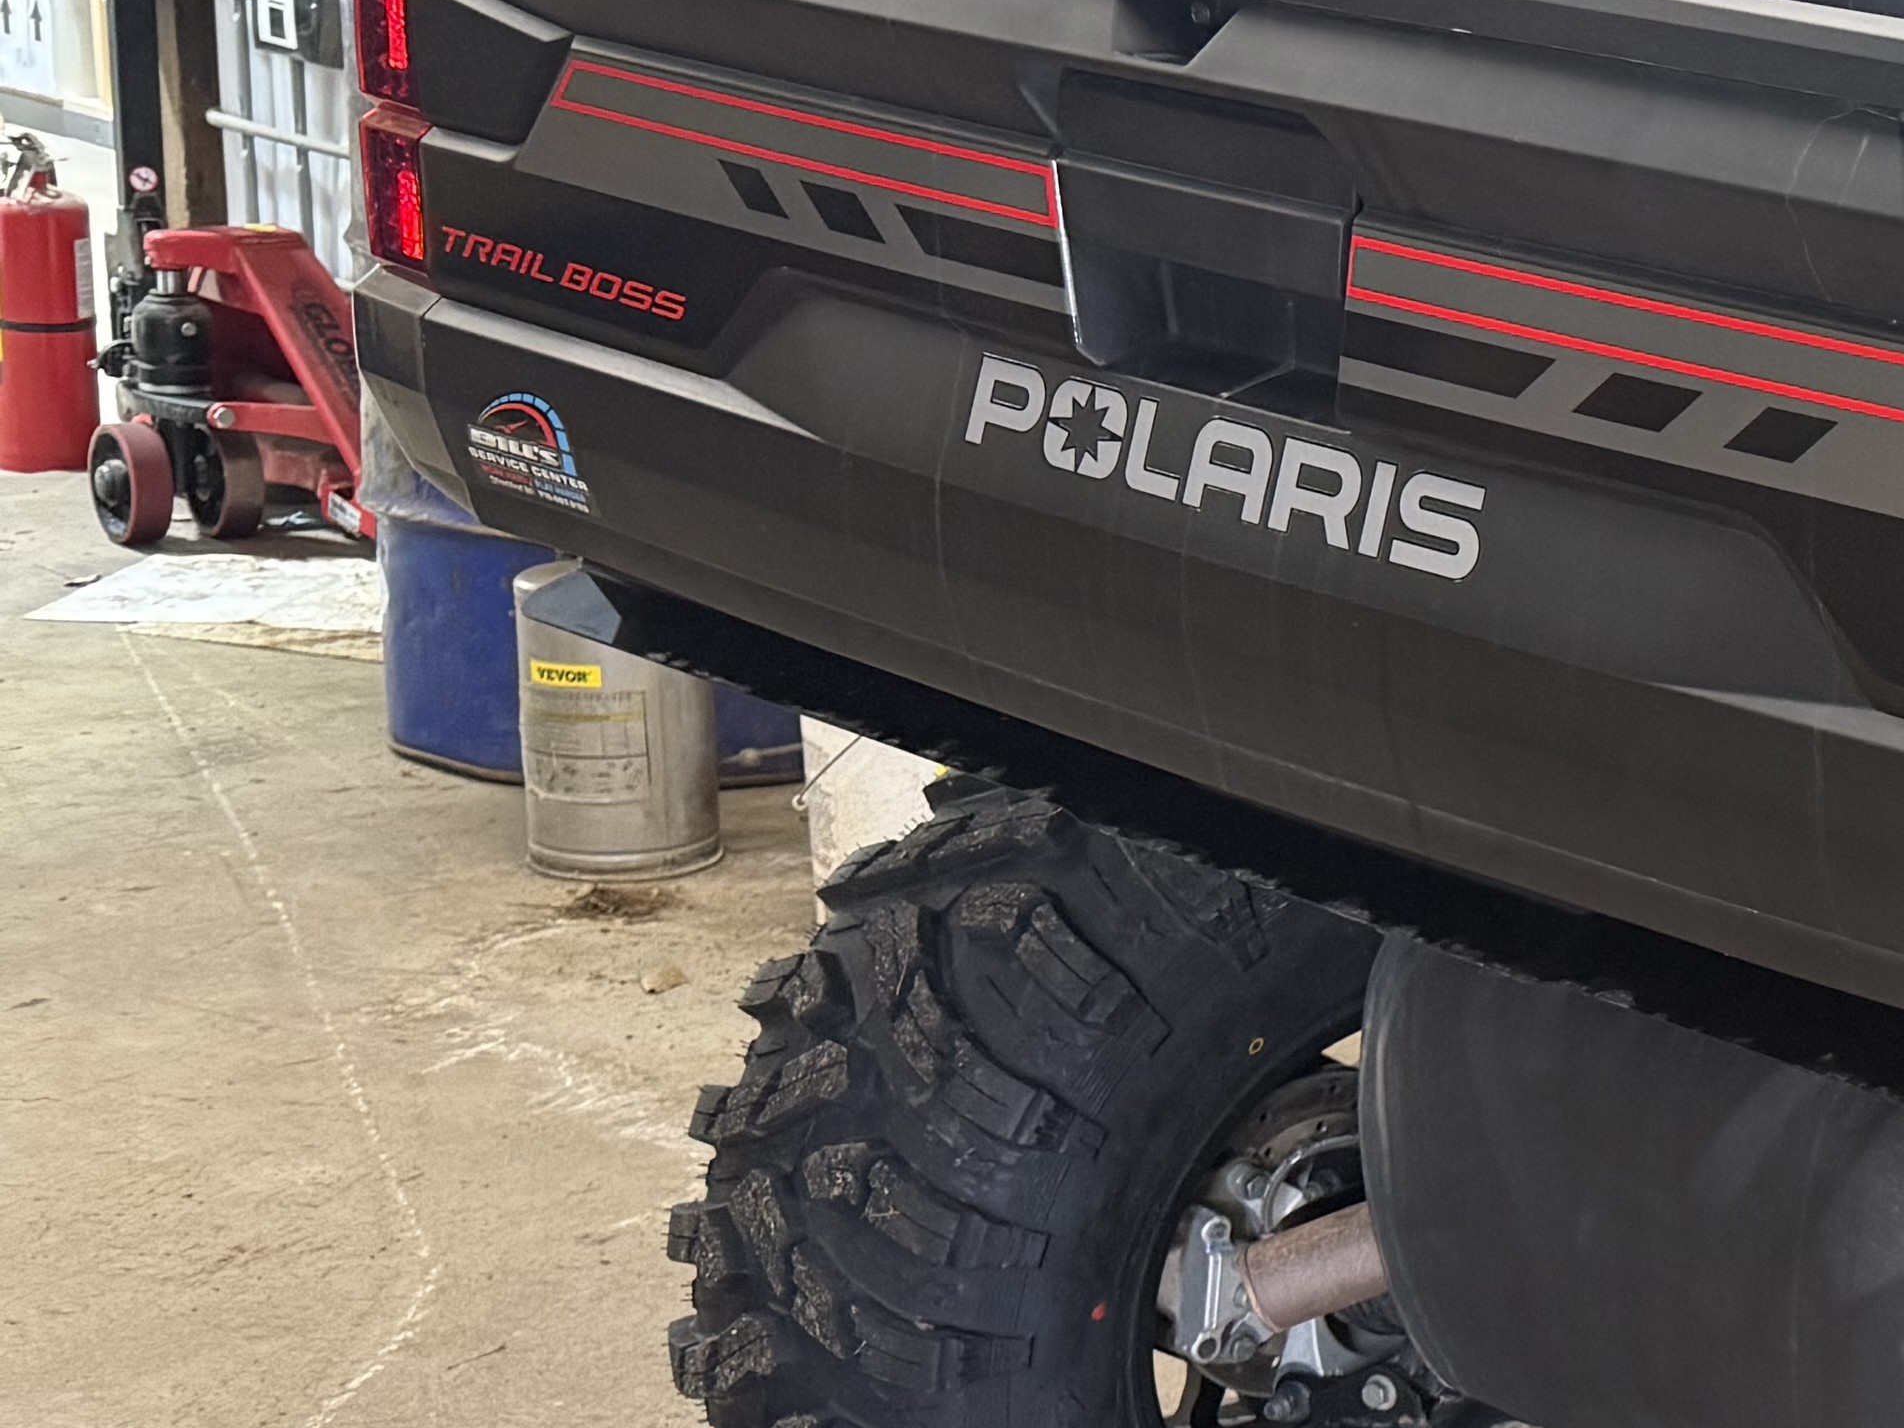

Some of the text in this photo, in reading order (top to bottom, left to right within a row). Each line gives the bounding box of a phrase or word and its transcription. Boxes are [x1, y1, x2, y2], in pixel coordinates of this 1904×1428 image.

[442, 225, 688, 321] TRAIL BOSS
[467, 445, 530, 473] SERVICE
[530, 465, 590, 492] CENTER
[469, 427, 560, 467] BILL'S
[963, 351, 1487, 582] POLARIS
[537, 666, 589, 683] VEVOR
